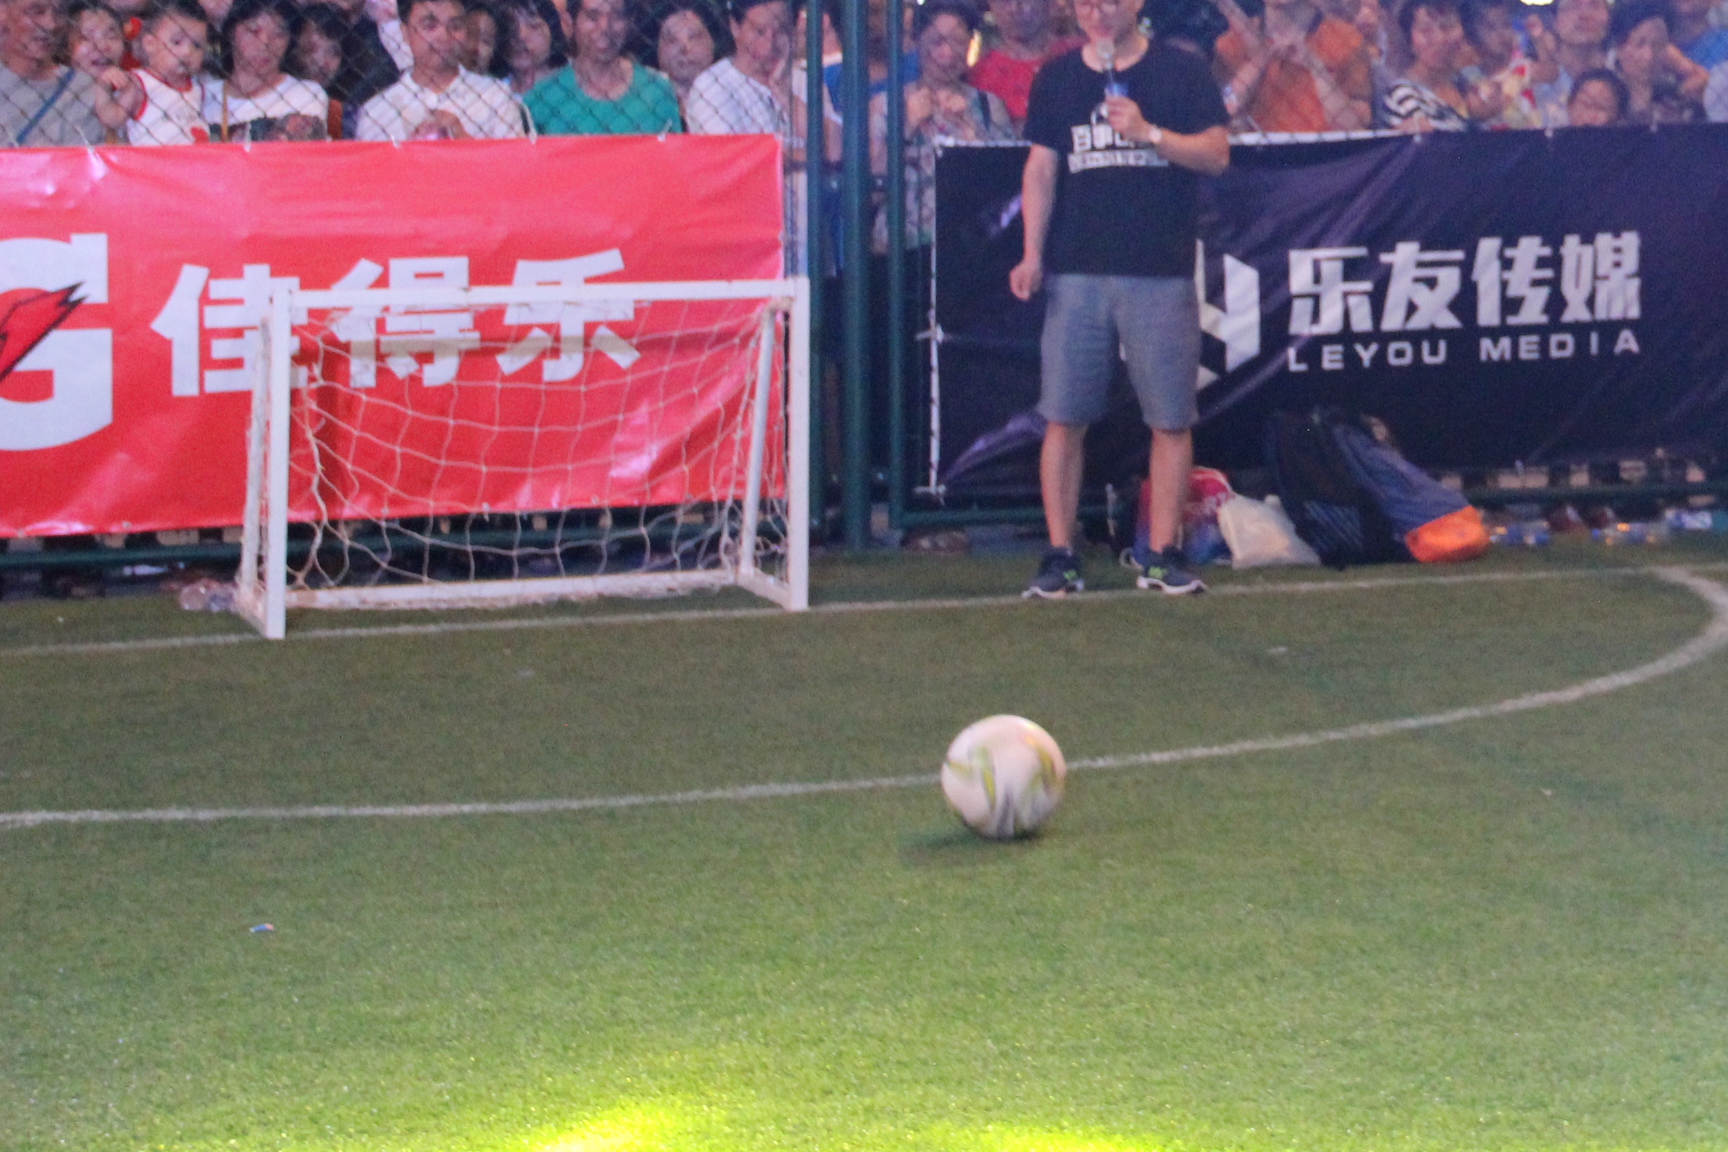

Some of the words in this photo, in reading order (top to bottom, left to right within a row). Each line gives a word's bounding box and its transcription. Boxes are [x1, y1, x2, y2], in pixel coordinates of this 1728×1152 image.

[150, 249, 642, 398] 佳得乐
[1288, 231, 1642, 335] 乐友传媒
[1288, 339, 1447, 373] LEYOU
[1479, 329, 1641, 363] MEDIA
